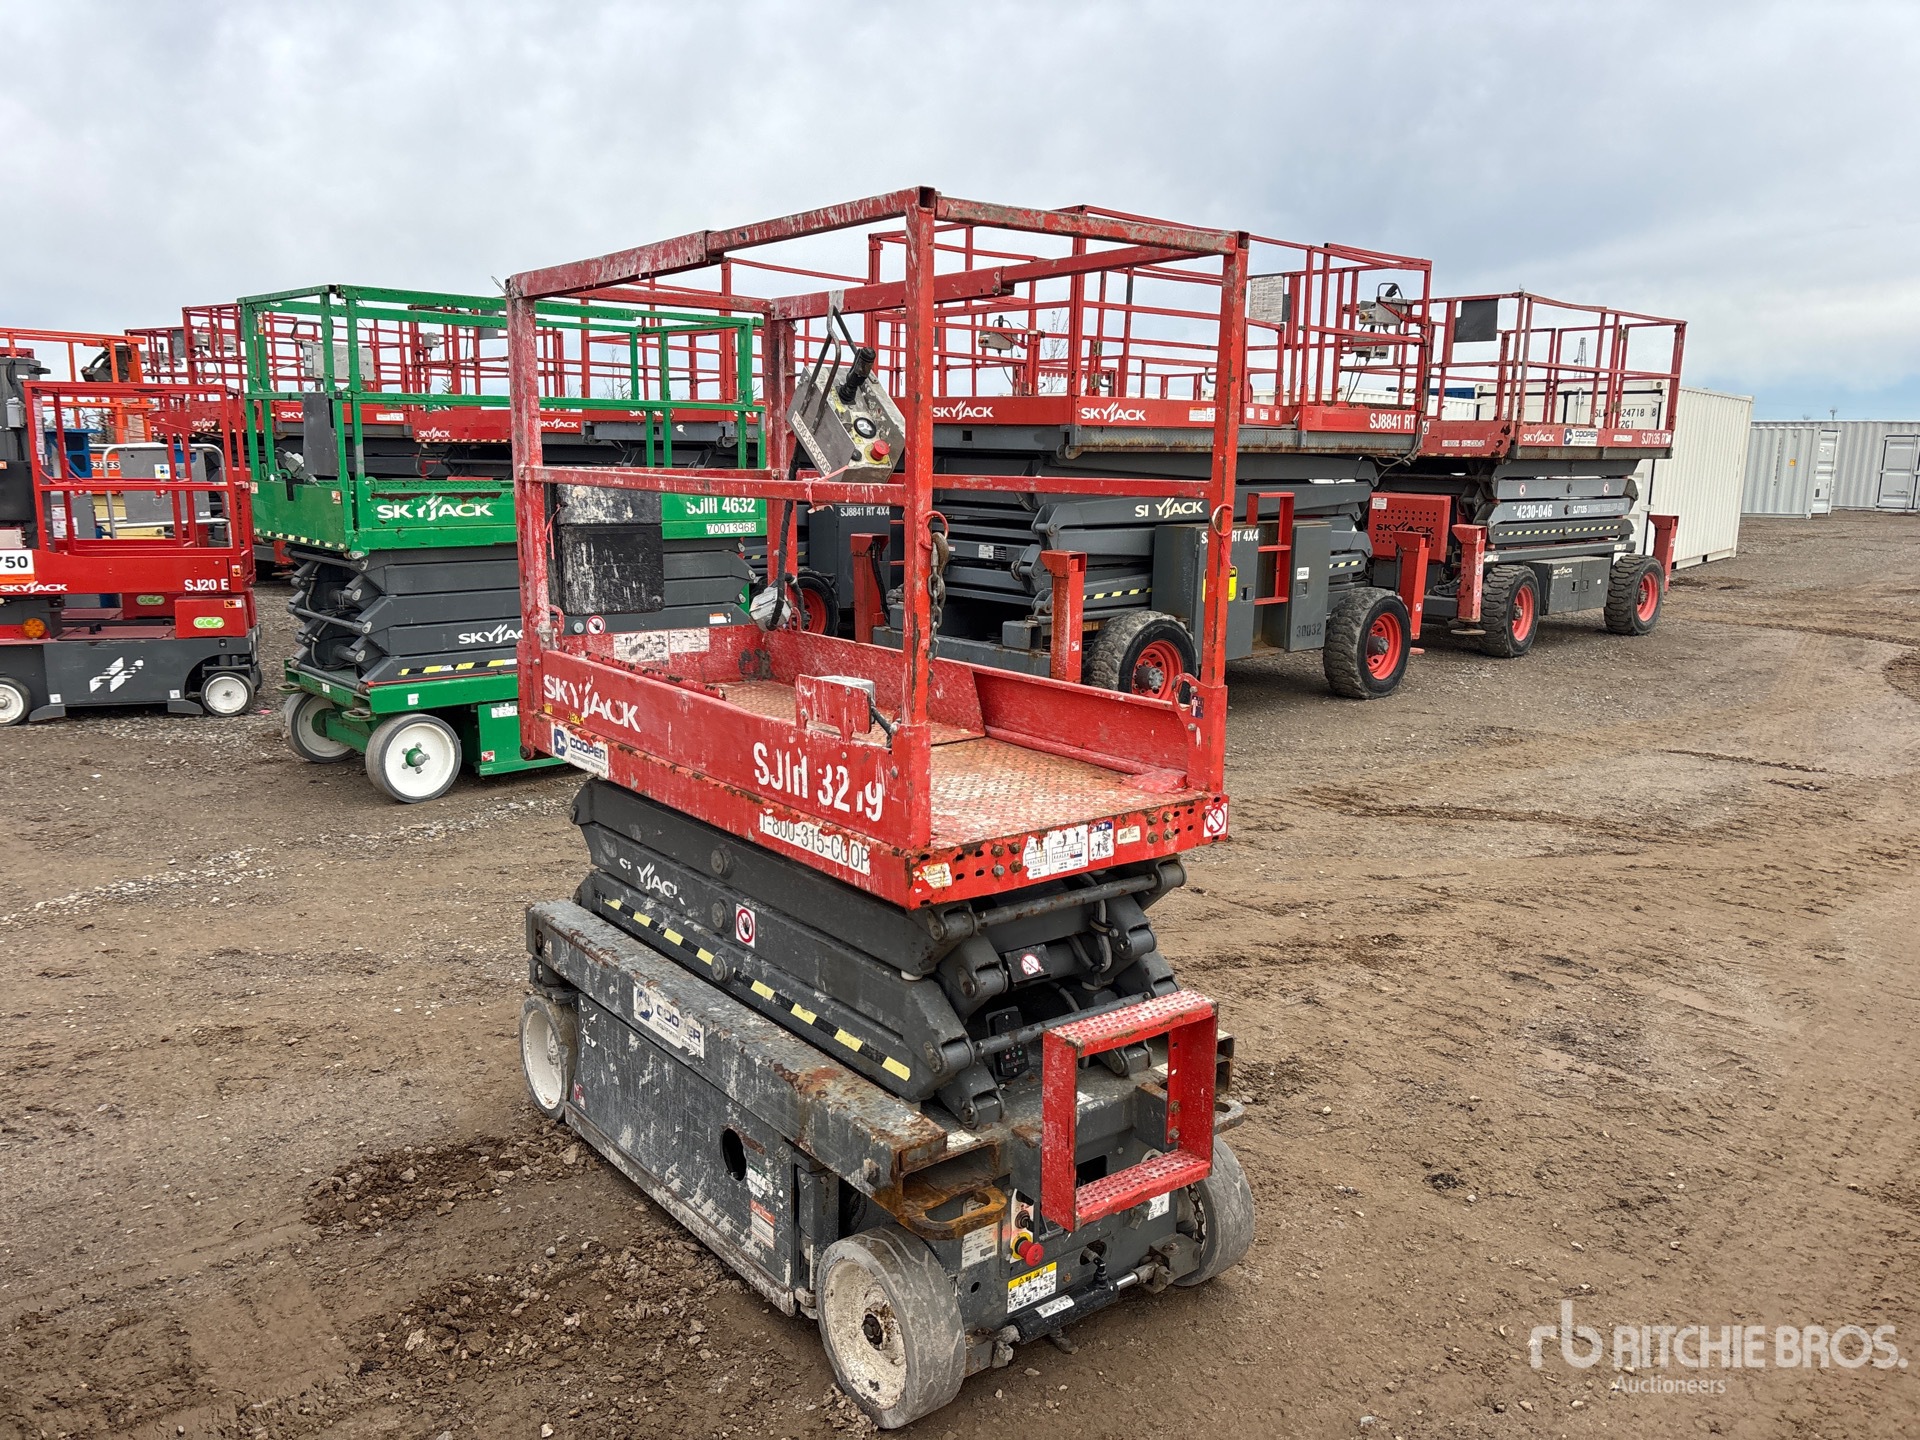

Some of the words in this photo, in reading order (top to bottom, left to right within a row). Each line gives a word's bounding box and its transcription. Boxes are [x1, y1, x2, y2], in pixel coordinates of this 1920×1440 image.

[933, 400, 994, 420] SKYJACK
[1080, 402, 1147, 423] SKYJACK
[1620, 408, 1645, 417] 24718
[1370, 413, 1401, 429] SJ8841
[1404, 414, 1415, 430] RT
[1619, 420, 1634, 429] 2G1
[418, 427, 450, 438] SKYJACK
[1522, 429, 1555, 444] SKYJACK
[377, 496, 494, 521] SKYJACK
[722, 497, 756, 514] 4632
[840, 506, 865, 517] SJ8841
[866, 506, 875, 516] RT
[876, 506, 891, 516] 4X4
[707, 522, 756, 534] 70013968
[1242, 529, 1260, 542] 4X4
[0, 580, 68, 594] SKYJACK
[184, 579, 217, 592] SJ20
[220, 579, 229, 591] E
[458, 623, 524, 644] SKYJA
[543, 674, 641, 733] SKYJACK
[569, 736, 607, 761] COOPER
[761, 814, 870, 872] 1-800-315-COOP
[656, 1004, 701, 1042] COOER
